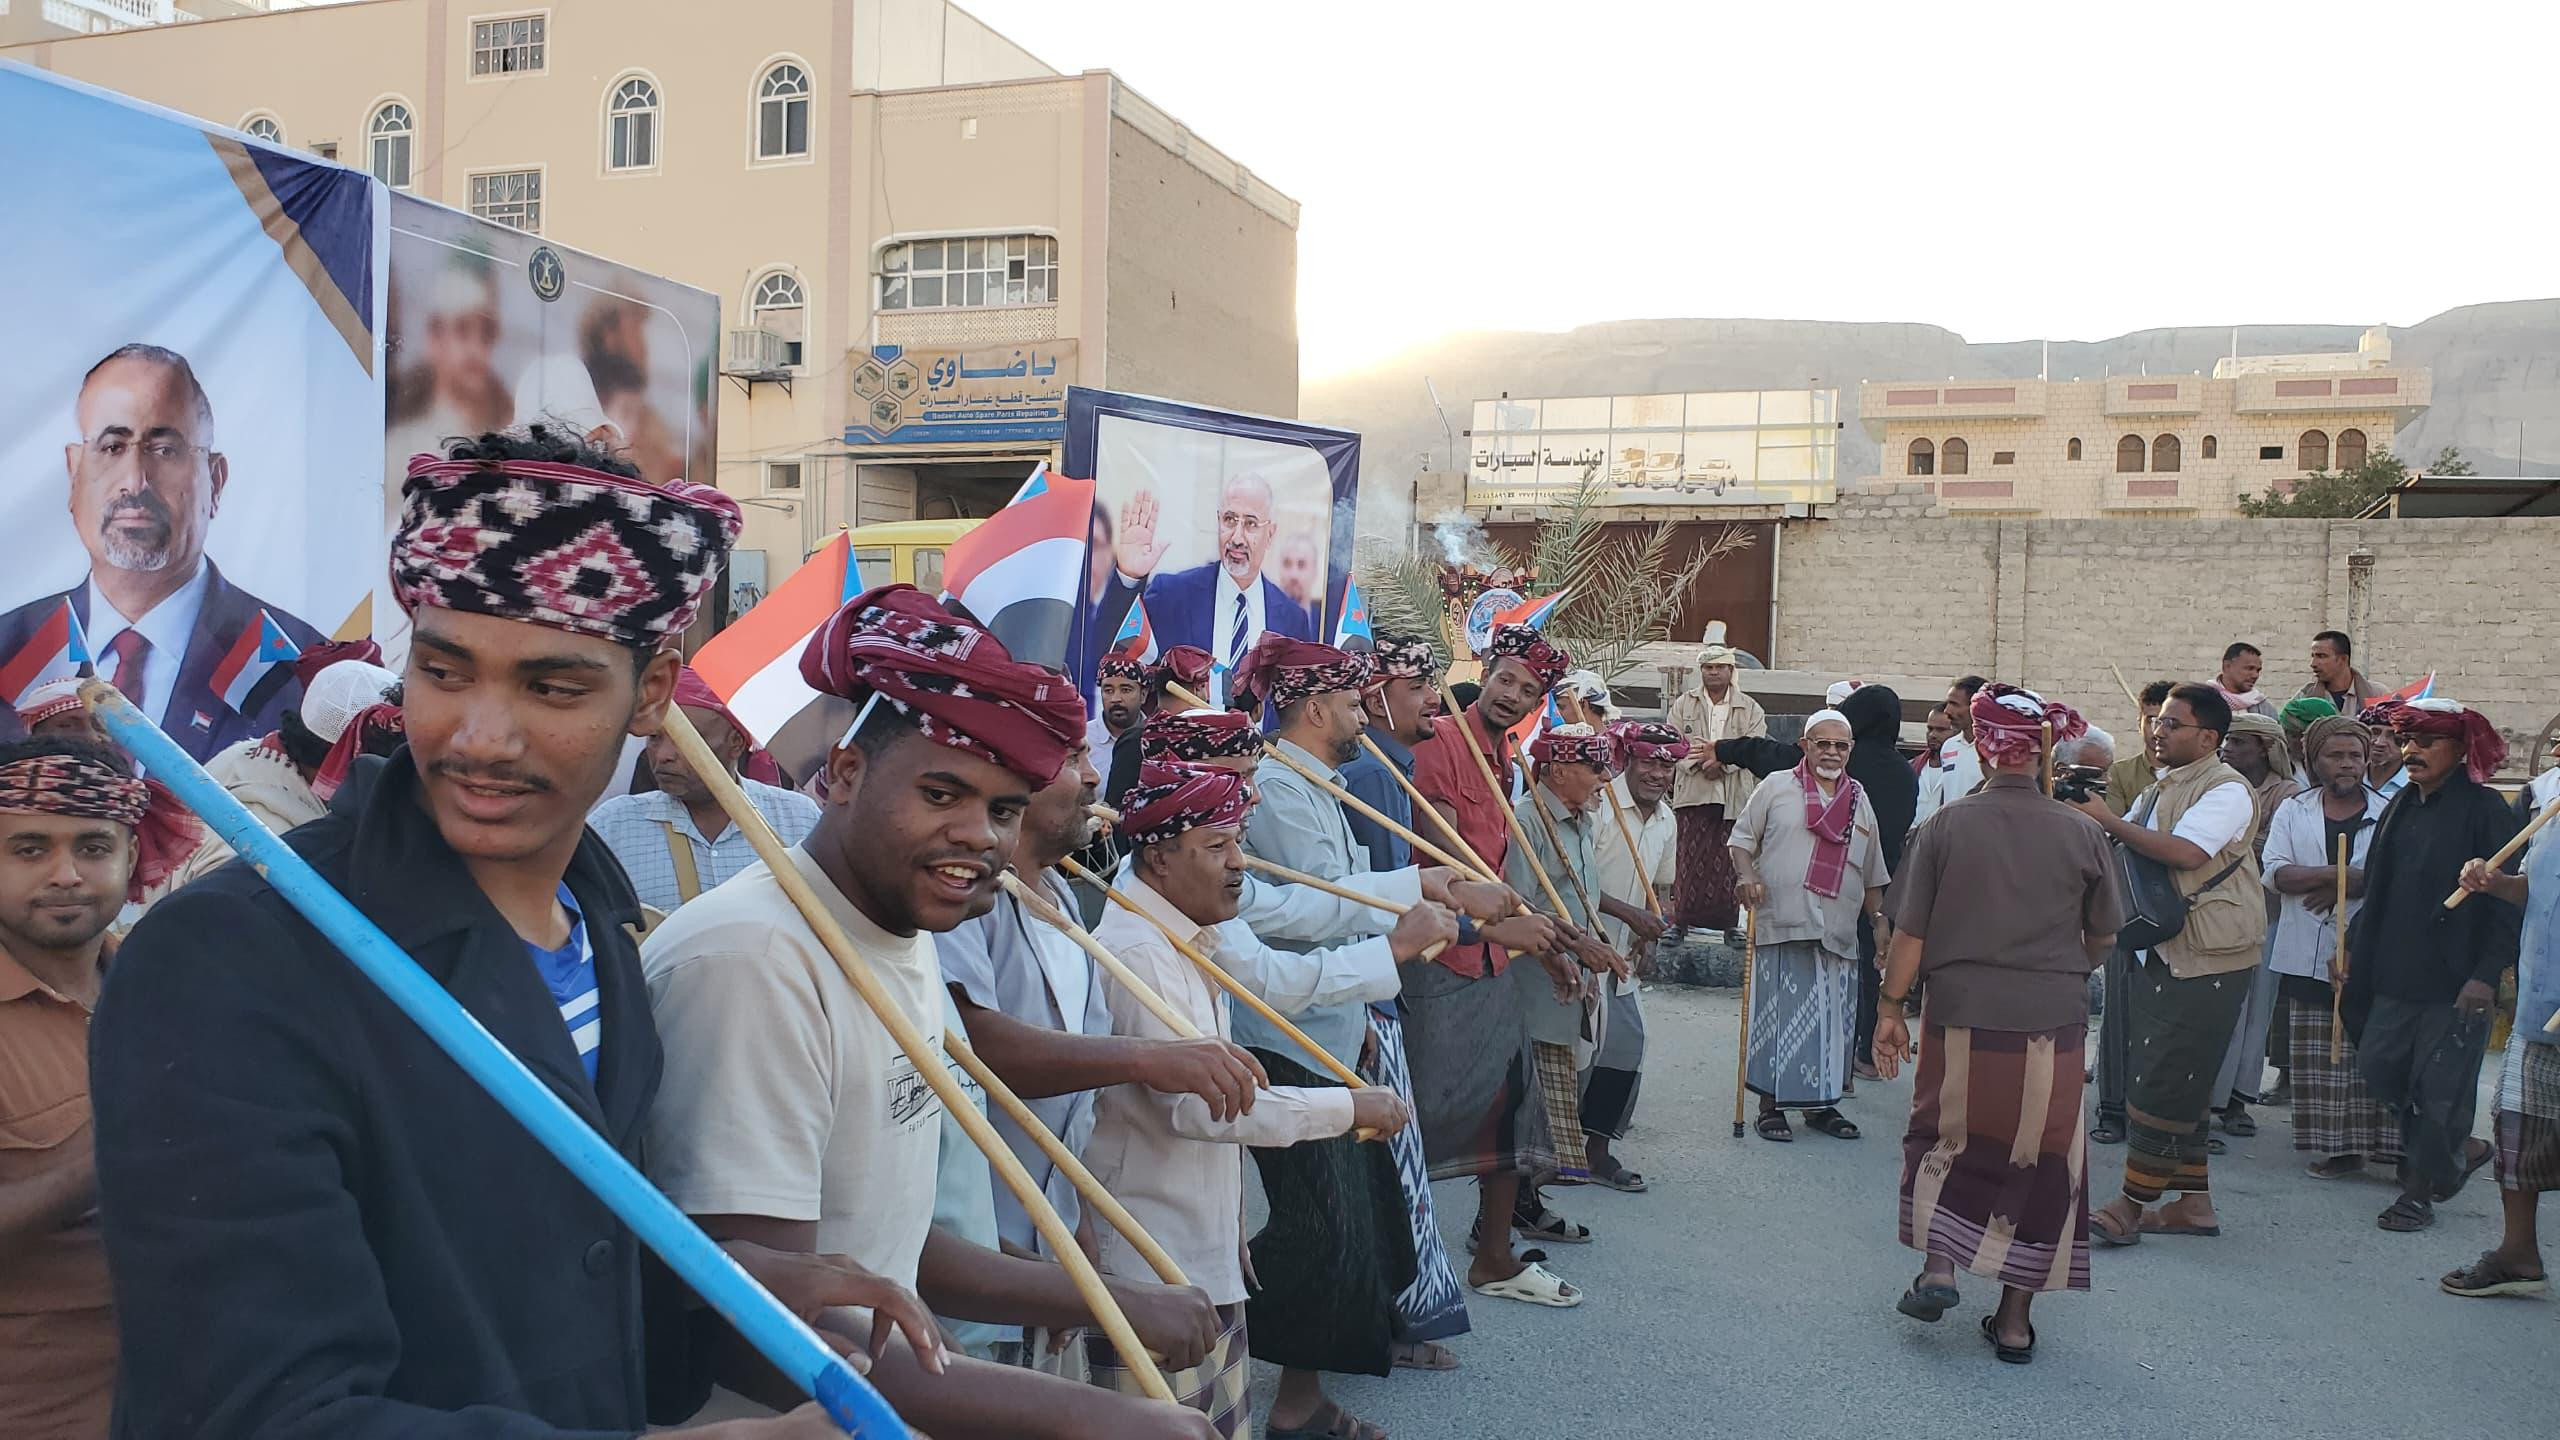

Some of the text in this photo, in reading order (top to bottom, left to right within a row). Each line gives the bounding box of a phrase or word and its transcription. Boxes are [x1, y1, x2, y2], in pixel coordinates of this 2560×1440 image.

[927, 350, 1057, 391] باضاوي
[919, 393, 963, 408] السيارات
[963, 392, 993, 407] غيار
[995, 390, 1023, 407] قطع
[957, 411, 974, 419] Auto
[975, 411, 995, 420] Spare
[998, 410, 1015, 418] Parts
[1016, 409, 1049, 418] Repairing
[1475, 449, 1540, 472] السيارات
